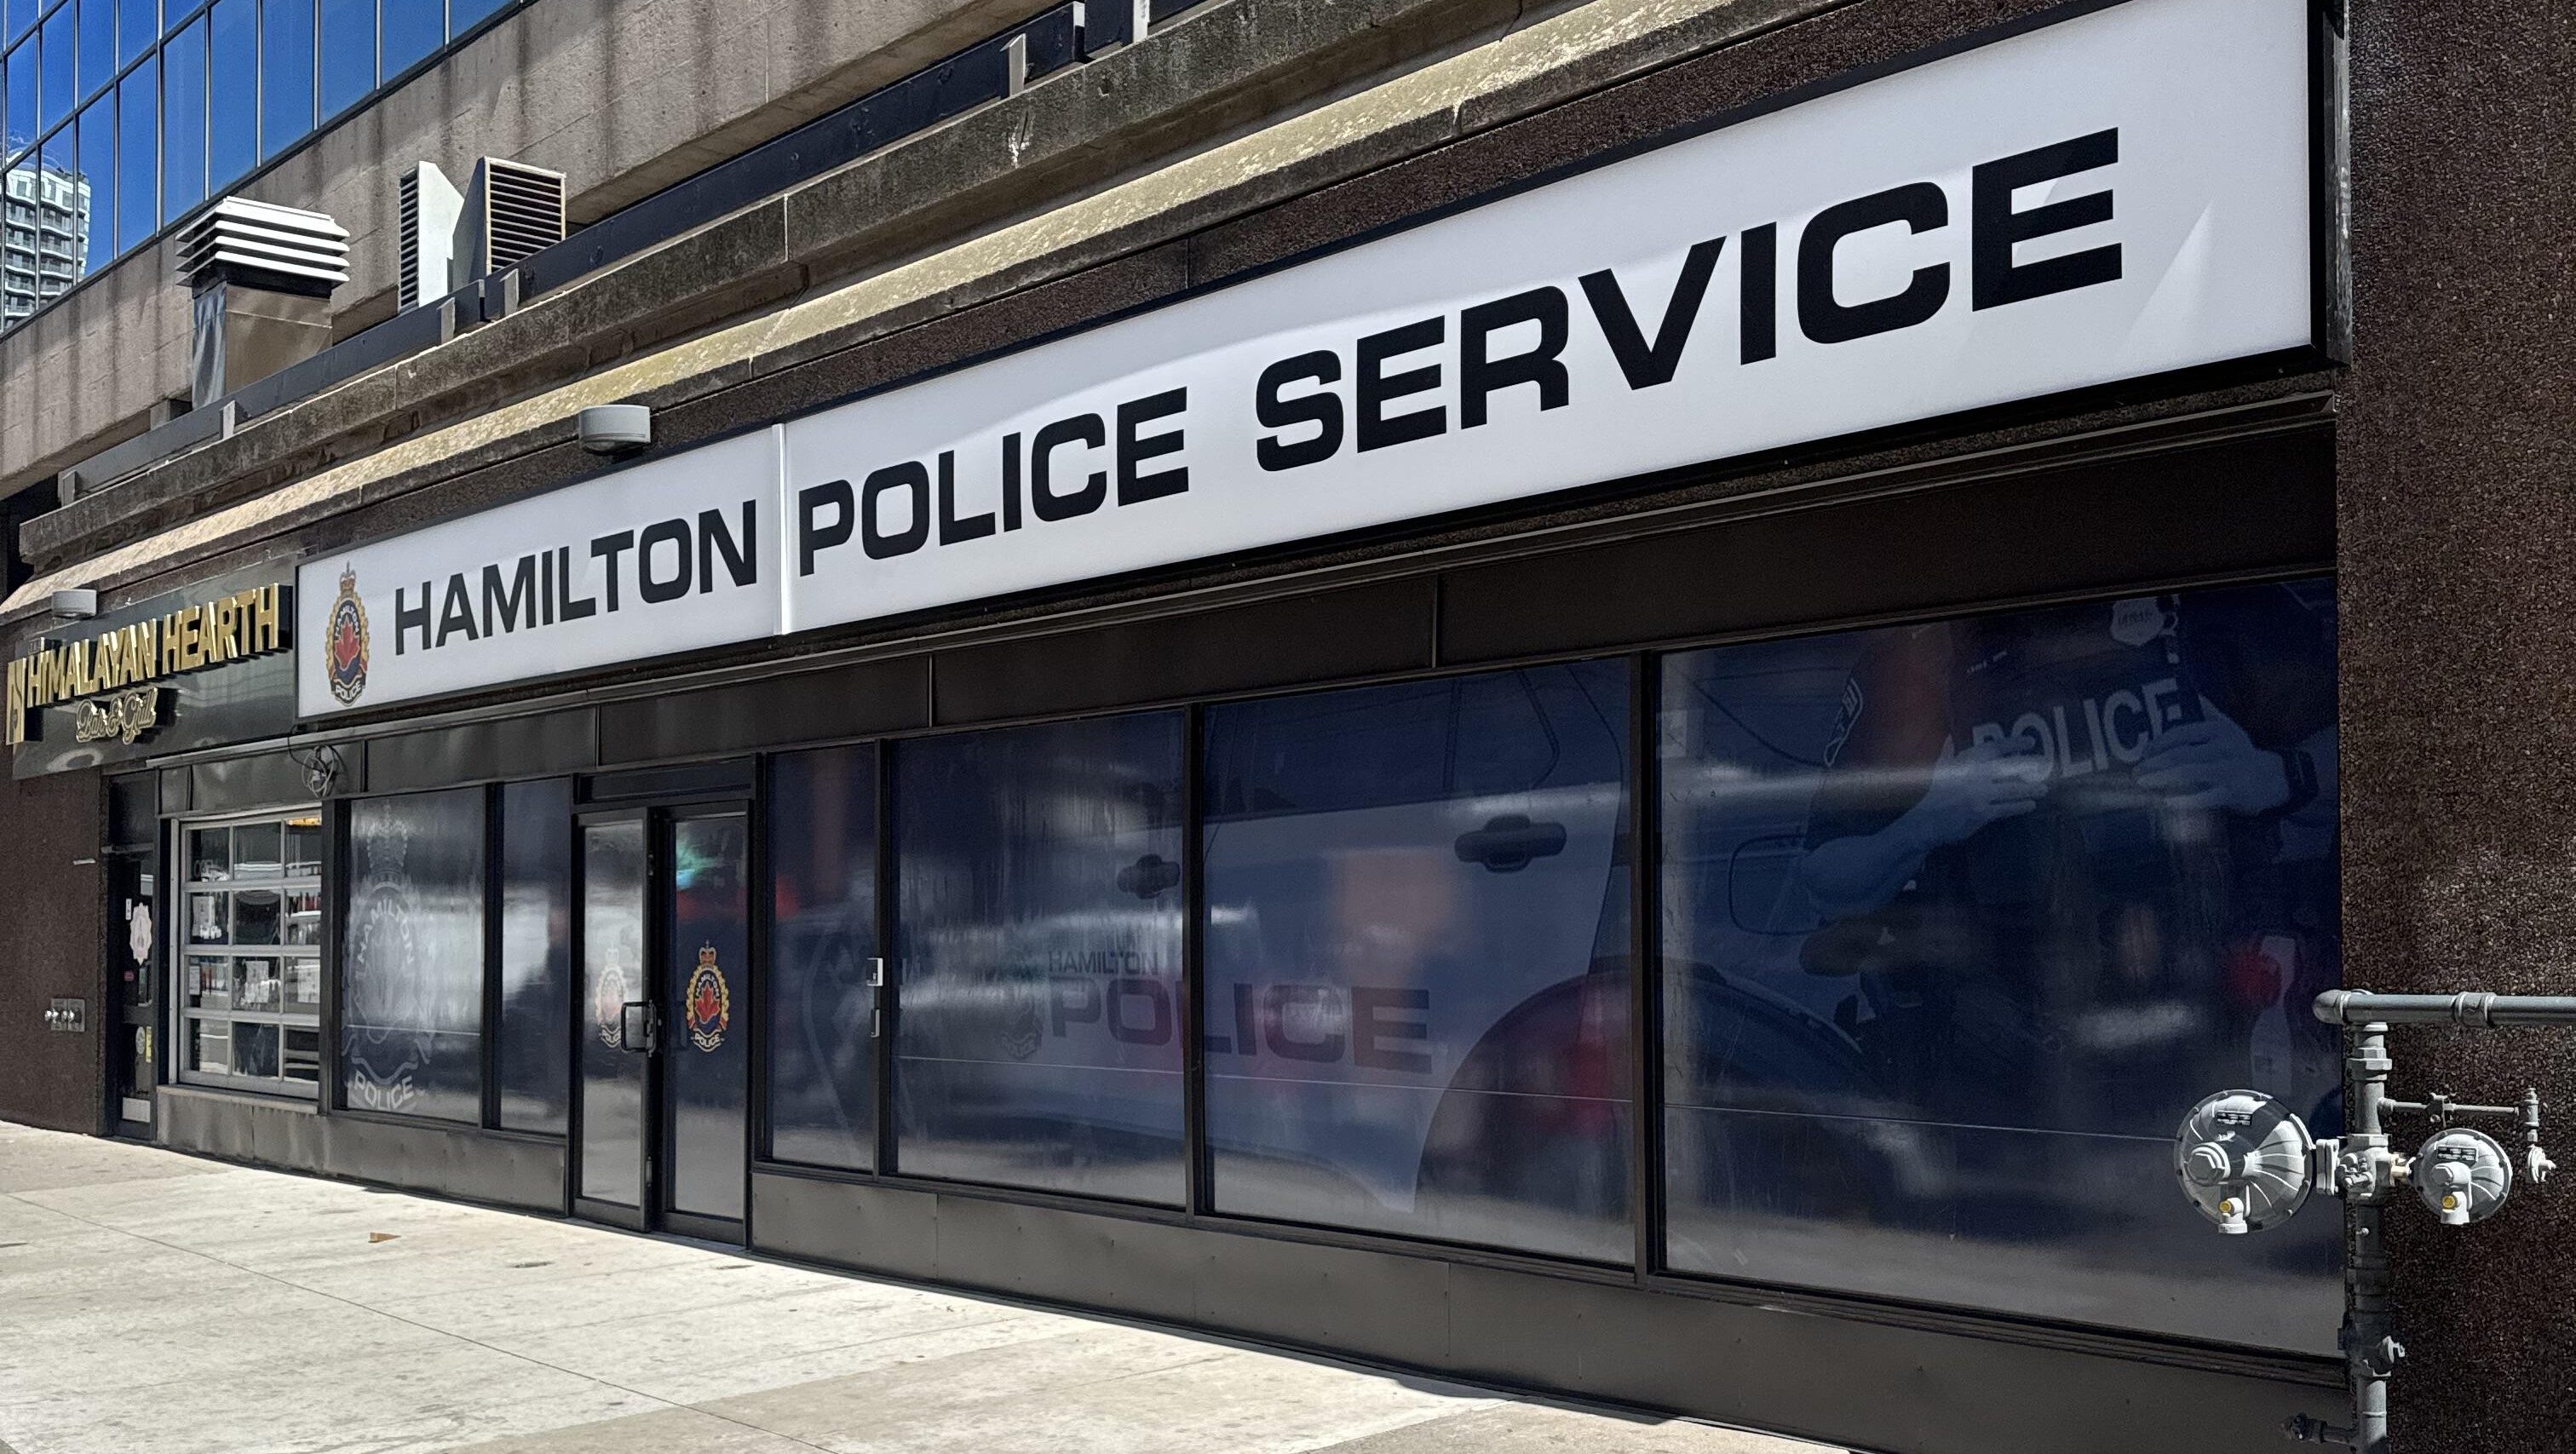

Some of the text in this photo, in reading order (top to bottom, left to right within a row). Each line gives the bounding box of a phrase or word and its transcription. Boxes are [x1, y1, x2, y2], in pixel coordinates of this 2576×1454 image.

[395, 127, 2123, 656] HAMILTON POLICE SERVICE
[336, 606, 359, 636] HAMILTON
[26, 583, 279, 708] HIMALAYAN HEARTH
[336, 682, 361, 700] POLICE
[106, 695, 122, 738] &
[121, 687, 158, 744] Grill
[357, 896, 415, 964] HAMILTON
[1049, 951, 1159, 976] HAMILTON
[695, 1033, 720, 1048] POLICE
[354, 1071, 414, 1112] POLICE
